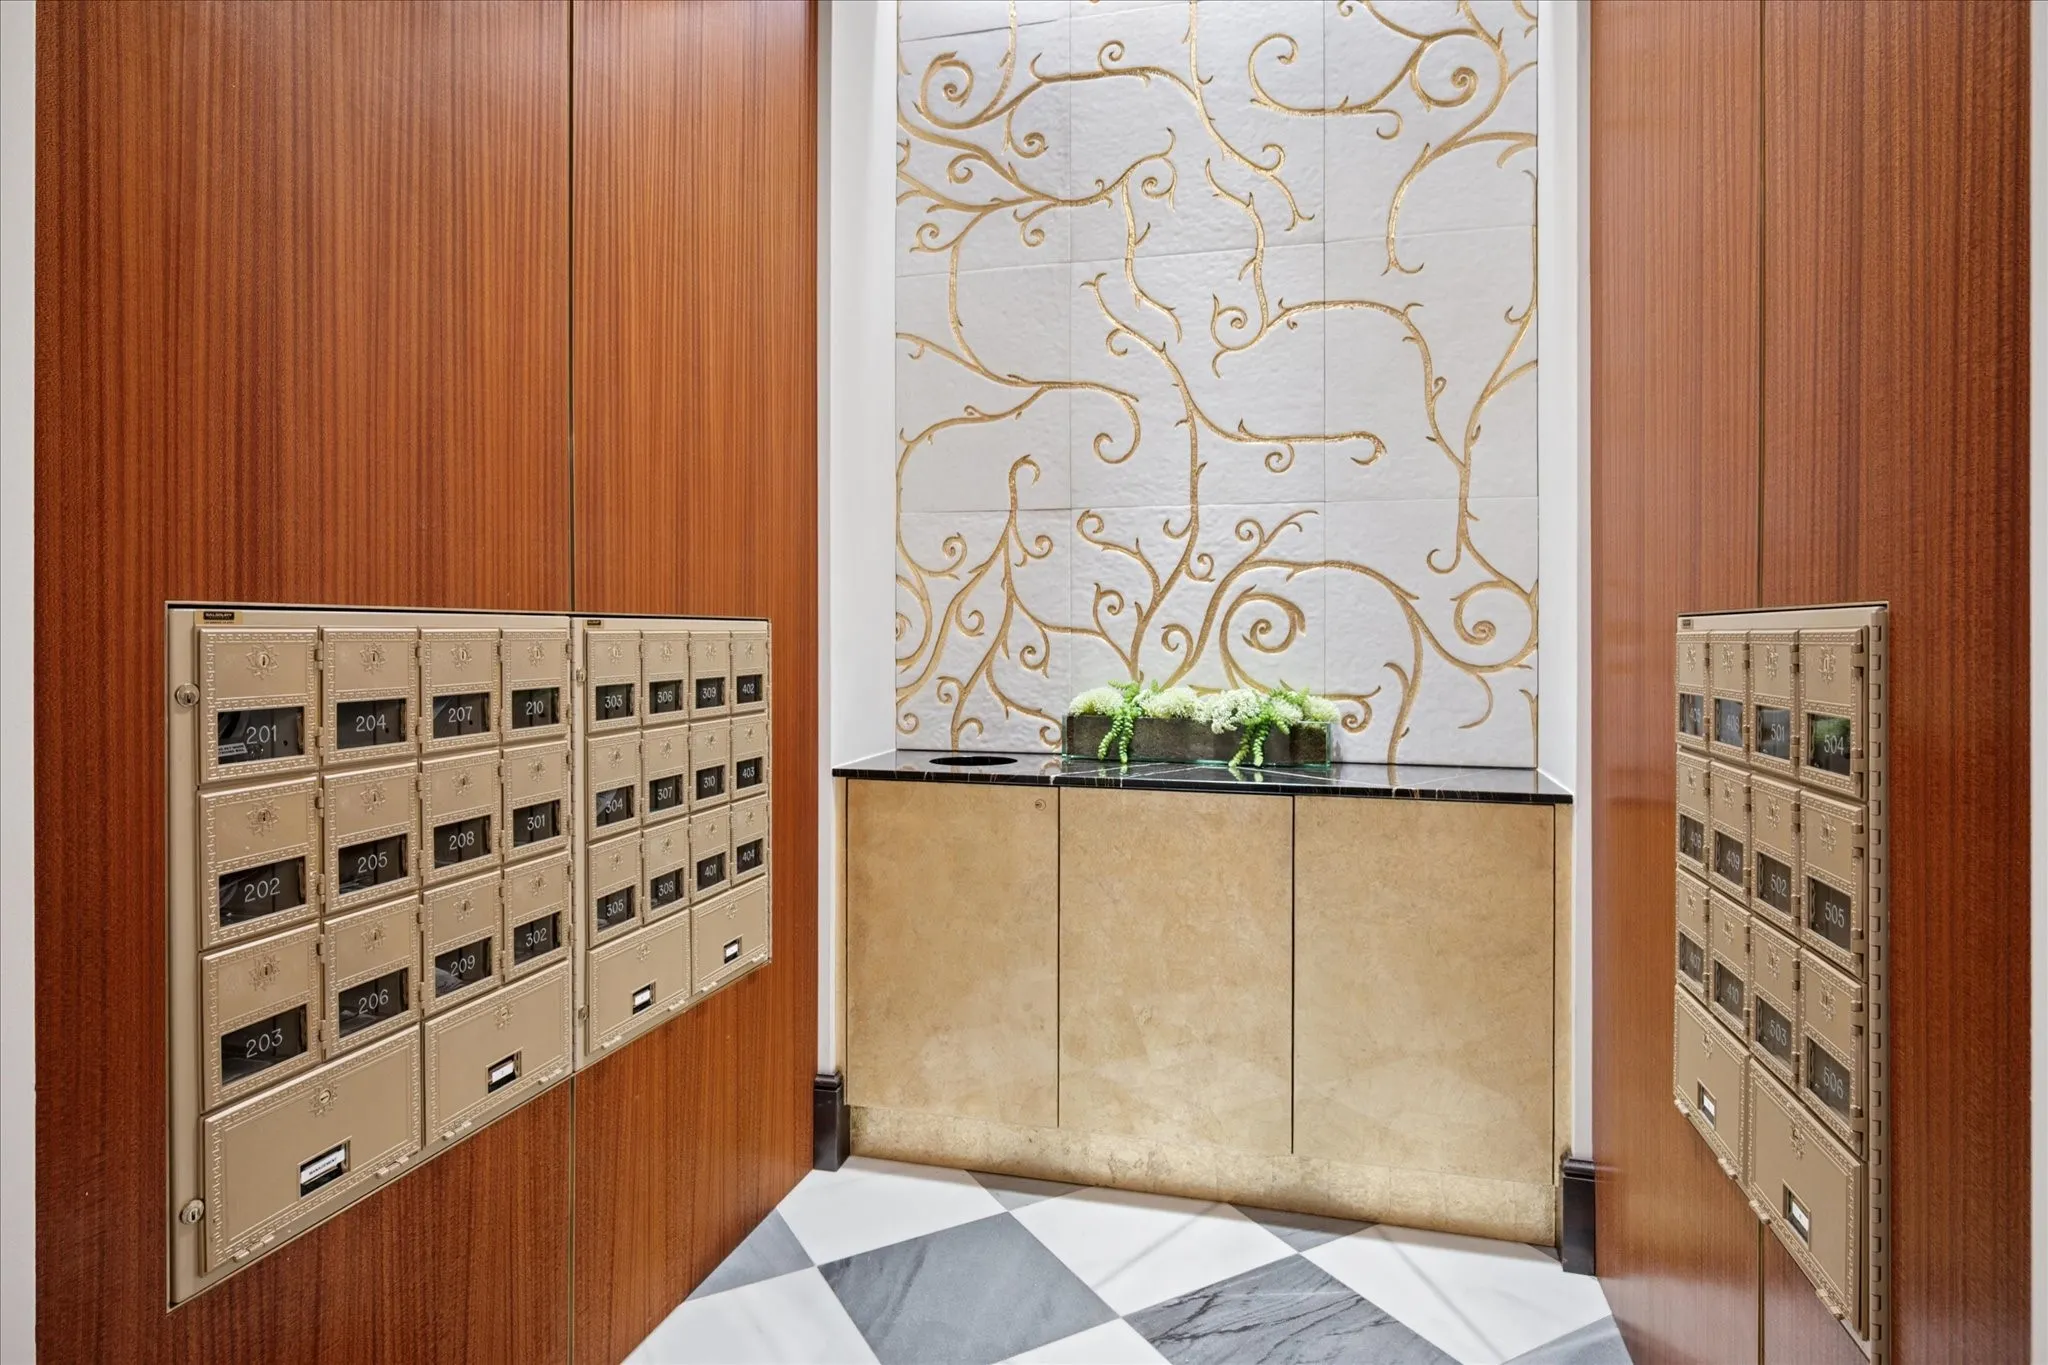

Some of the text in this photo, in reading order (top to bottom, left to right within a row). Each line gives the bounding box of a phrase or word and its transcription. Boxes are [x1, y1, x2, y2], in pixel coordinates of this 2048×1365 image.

[703, 687, 717, 699] 309
[743, 683, 754, 694] 402
[605, 694, 623, 708] 303
[657, 691, 673, 704] 306
[448, 706, 473, 722] 207
[526, 700, 544, 715] 210
[356, 715, 386, 732] 204
[246, 726, 277, 744] 201
[1771, 724, 1785, 743] 501
[1824, 735, 1844, 755] 504
[743, 768, 755, 778] 403
[704, 776, 715, 788] 310
[657, 786, 672, 801] 307
[605, 800, 623, 814] 304
[527, 815, 545, 831] 301
[449, 832, 475, 850] 208
[358, 852, 387, 873] 205
[742, 851, 754, 862] 404
[1727, 852, 1739, 870] 409
[704, 866, 716, 877] 401
[244, 878, 280, 903] 202
[658, 881, 673, 897] 308
[1771, 874, 1787, 897] 502
[607, 899, 624, 916] 305
[1825, 904, 1844, 927] 505
[526, 928, 547, 947] 302
[450, 956, 476, 975] 209
[358, 989, 389, 1014] 206
[246, 1028, 283, 1057] 203
[1769, 1021, 1787, 1047] 503
[1823, 1065, 1844, 1098] 506
